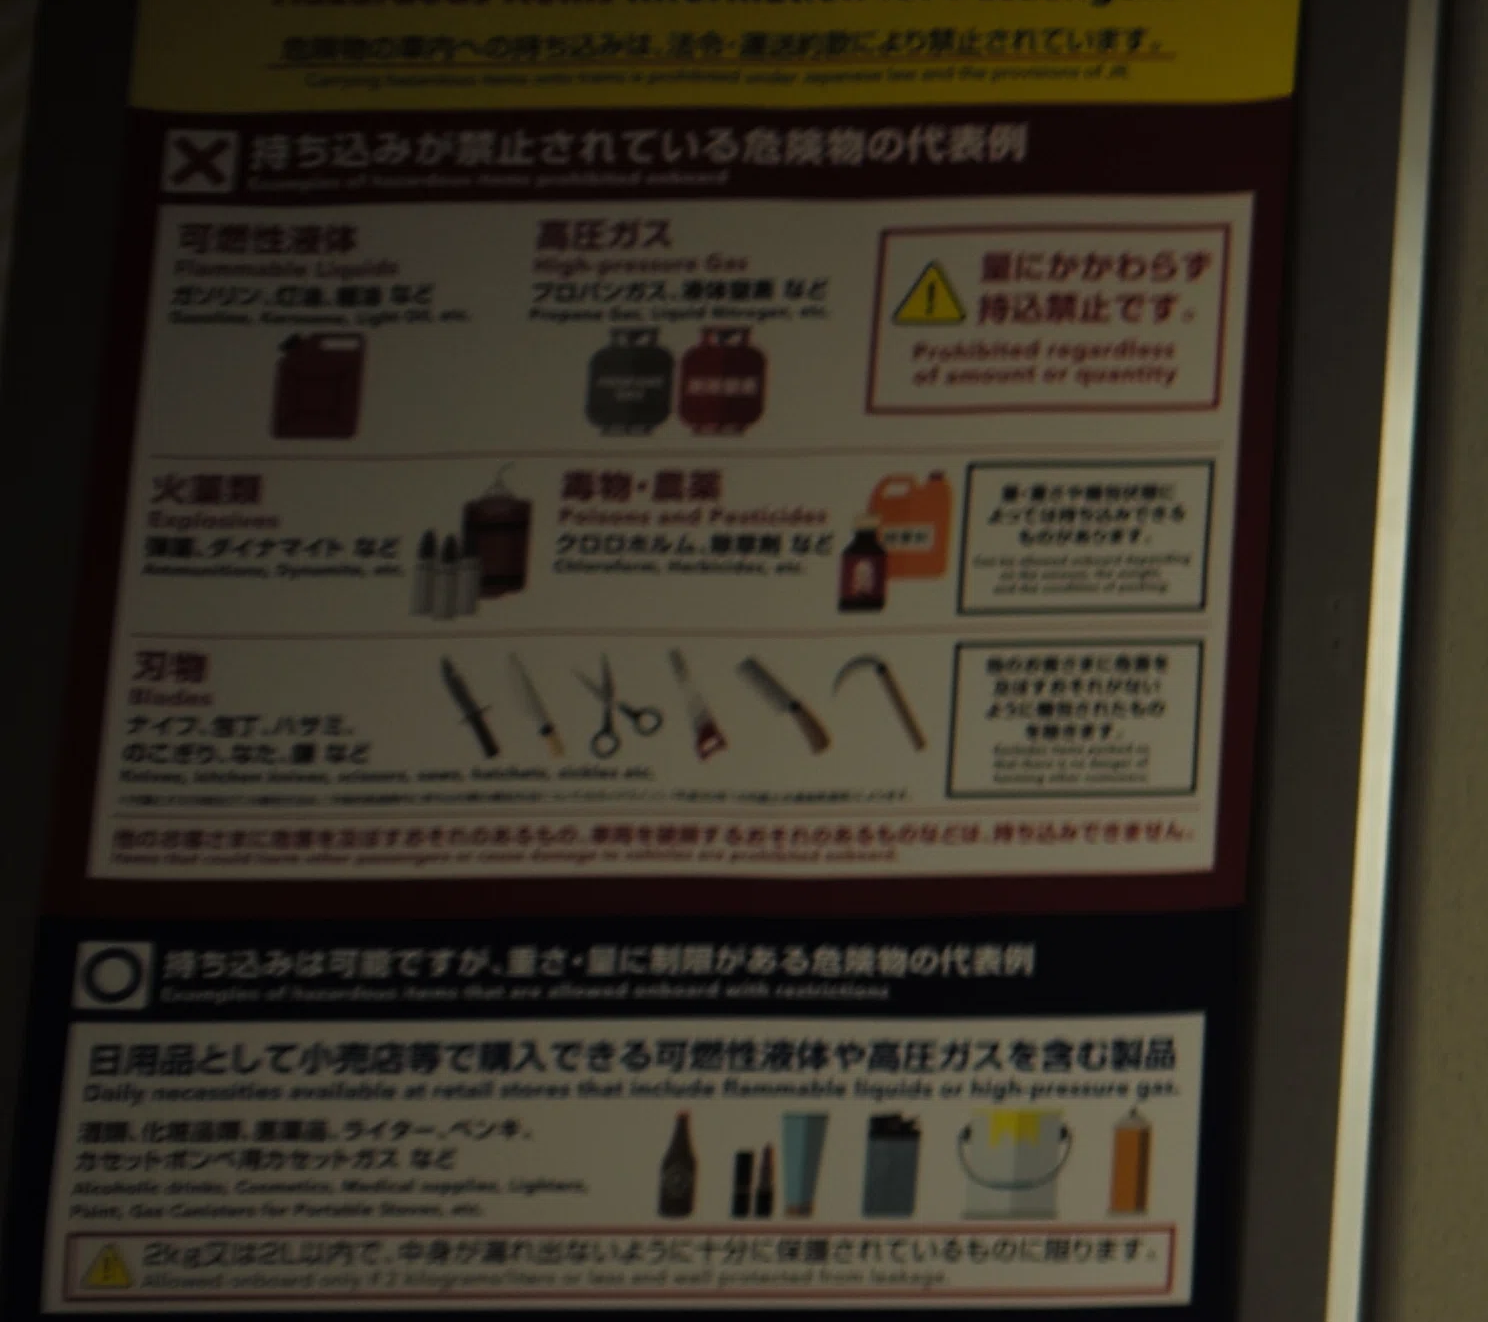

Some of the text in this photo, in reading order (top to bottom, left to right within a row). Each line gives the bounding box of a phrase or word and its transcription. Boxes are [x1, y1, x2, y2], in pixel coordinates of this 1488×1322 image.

[249, 121, 1028, 172] 持ち込みが禁止されている危険物の代表例
[409, 1145, 458, 1171] など
